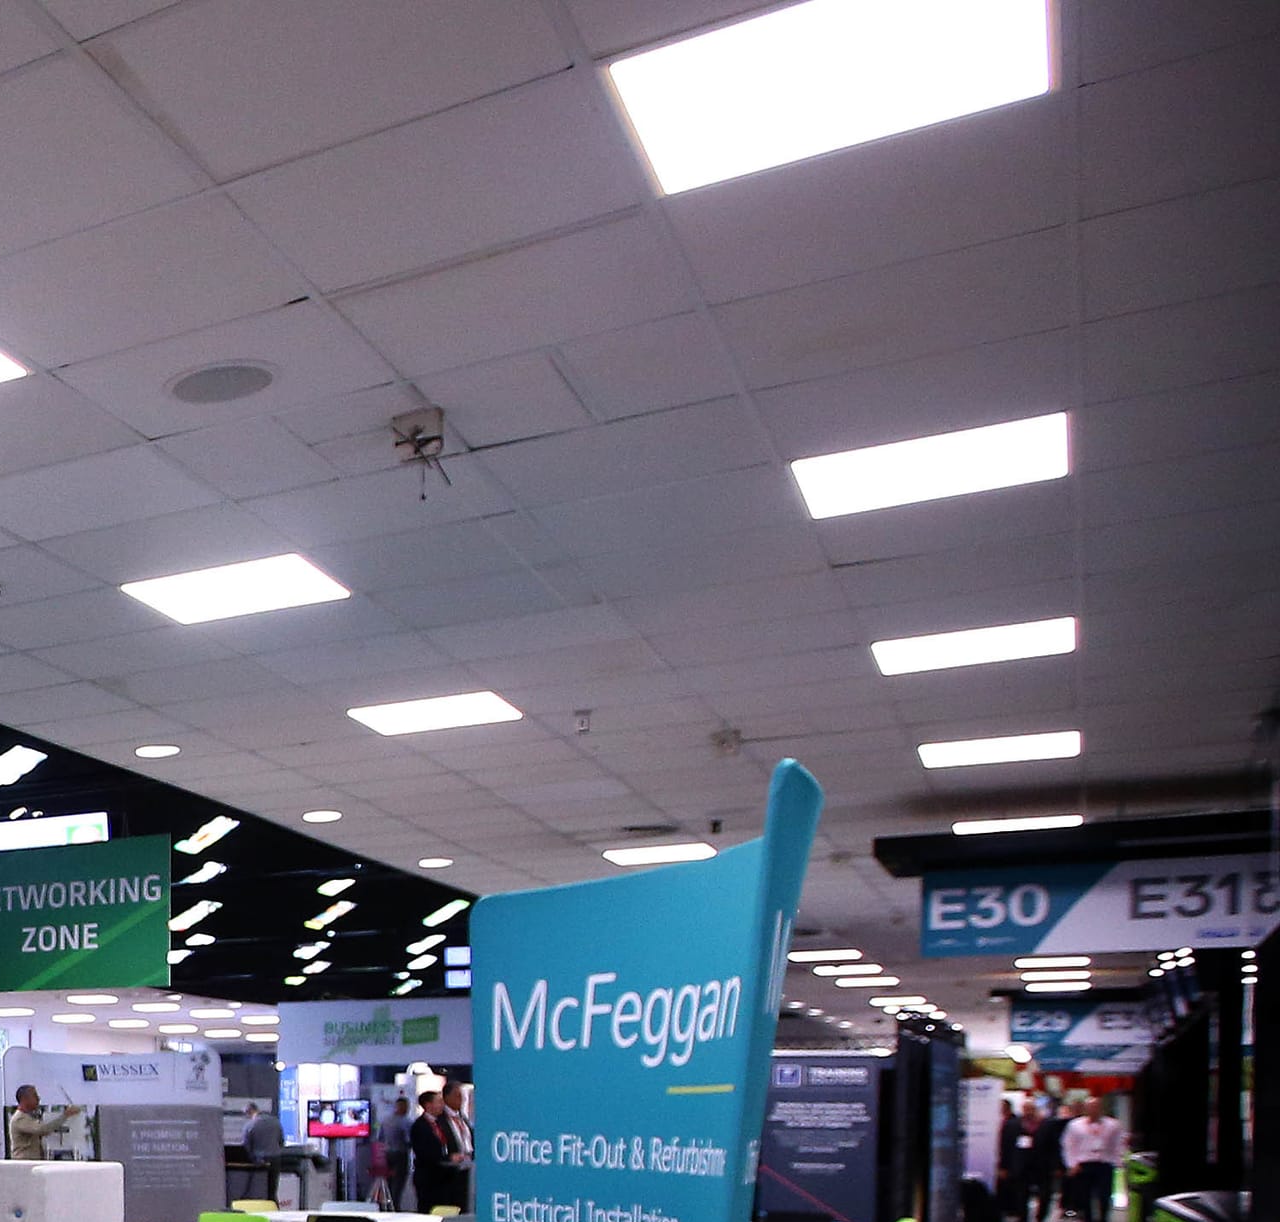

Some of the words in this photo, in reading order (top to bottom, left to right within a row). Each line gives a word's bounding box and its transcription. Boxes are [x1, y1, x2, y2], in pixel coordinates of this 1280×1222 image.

[928, 883, 1051, 931] E30
[21, 923, 100, 952] ZONE
[491, 970, 741, 1068] McFeggan
[100, 1063, 159, 1076] WESSEX
[494, 1131, 552, 1165] Office
[558, 1133, 626, 1170] Fit-Out
[630, 1136, 646, 1171] &
